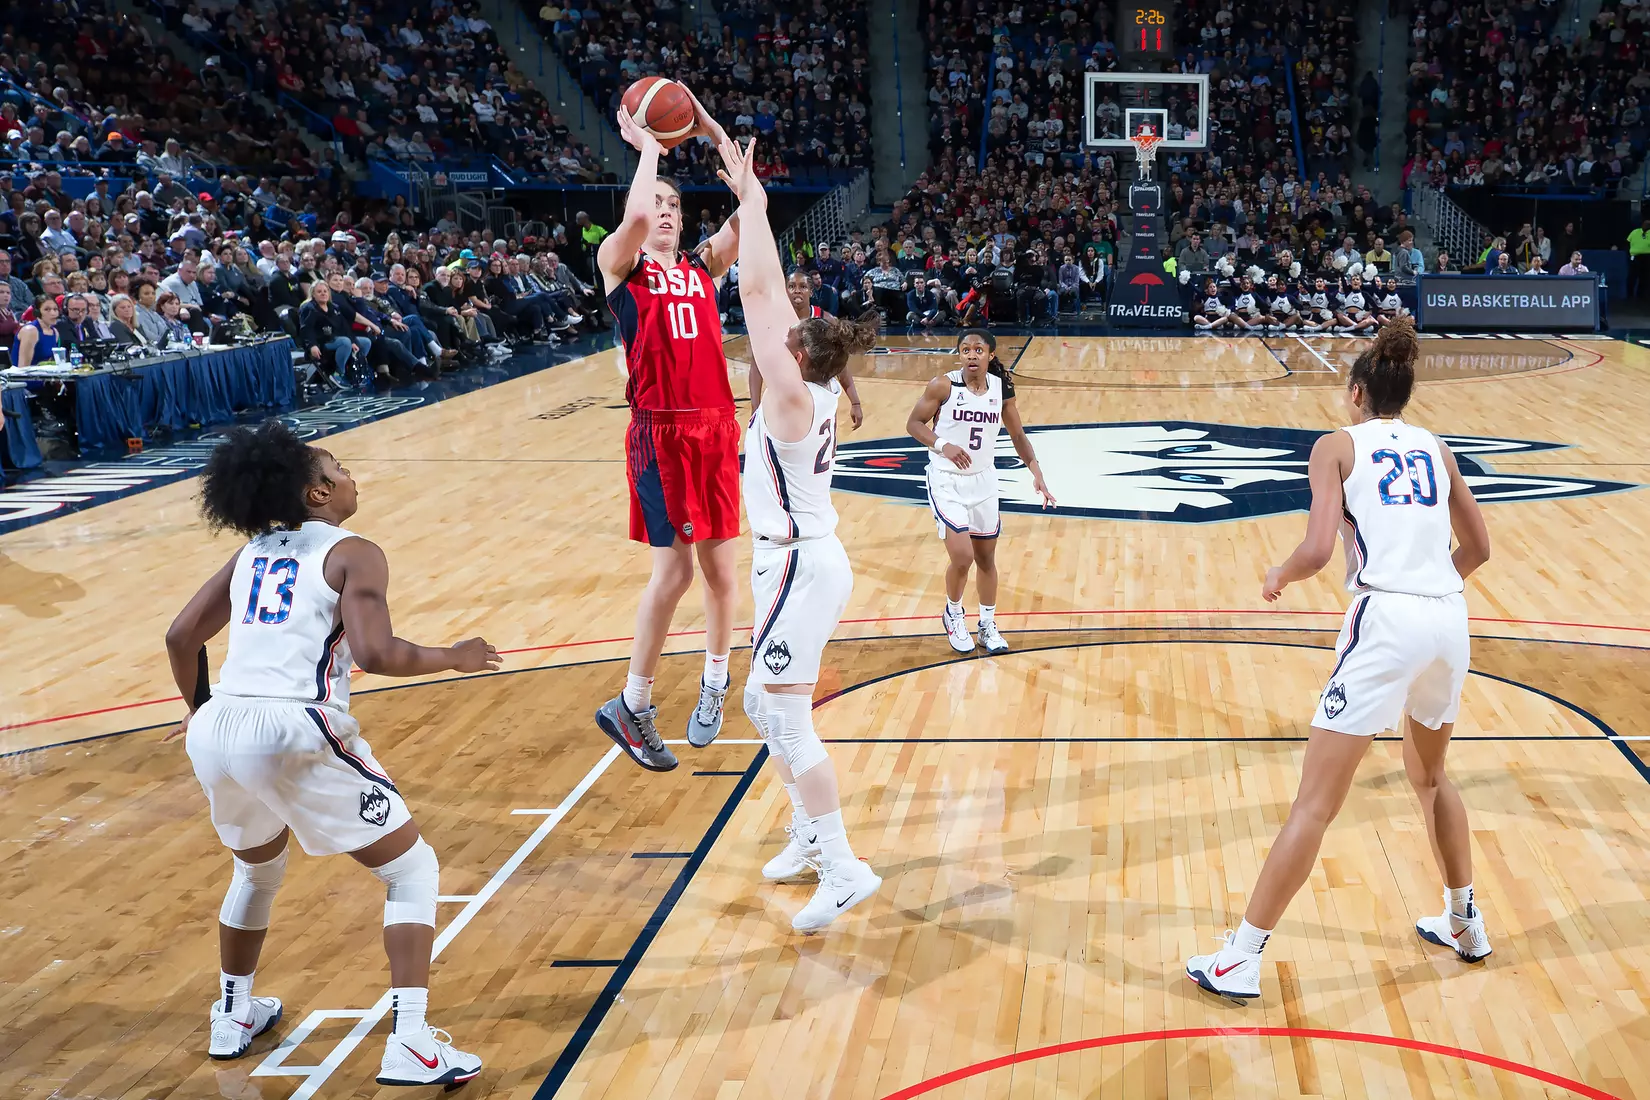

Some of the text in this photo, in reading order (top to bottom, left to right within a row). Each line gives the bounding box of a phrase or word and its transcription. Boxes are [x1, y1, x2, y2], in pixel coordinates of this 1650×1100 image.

[1135, 9, 1165, 25] 2:26
[1141, 28, 1162, 51] 11
[467, 172, 487, 180] LIGHT
[647, 268, 706, 299] USA
[1110, 304, 1182, 318] TRAVELERS
[1427, 294, 1591, 309] USA BASKETBALL APP
[667, 302, 699, 339] 10
[952, 409, 1000, 424] UCONN
[968, 426, 983, 451] 5
[1371, 448, 1438, 507] 20
[242, 557, 300, 625] 13
